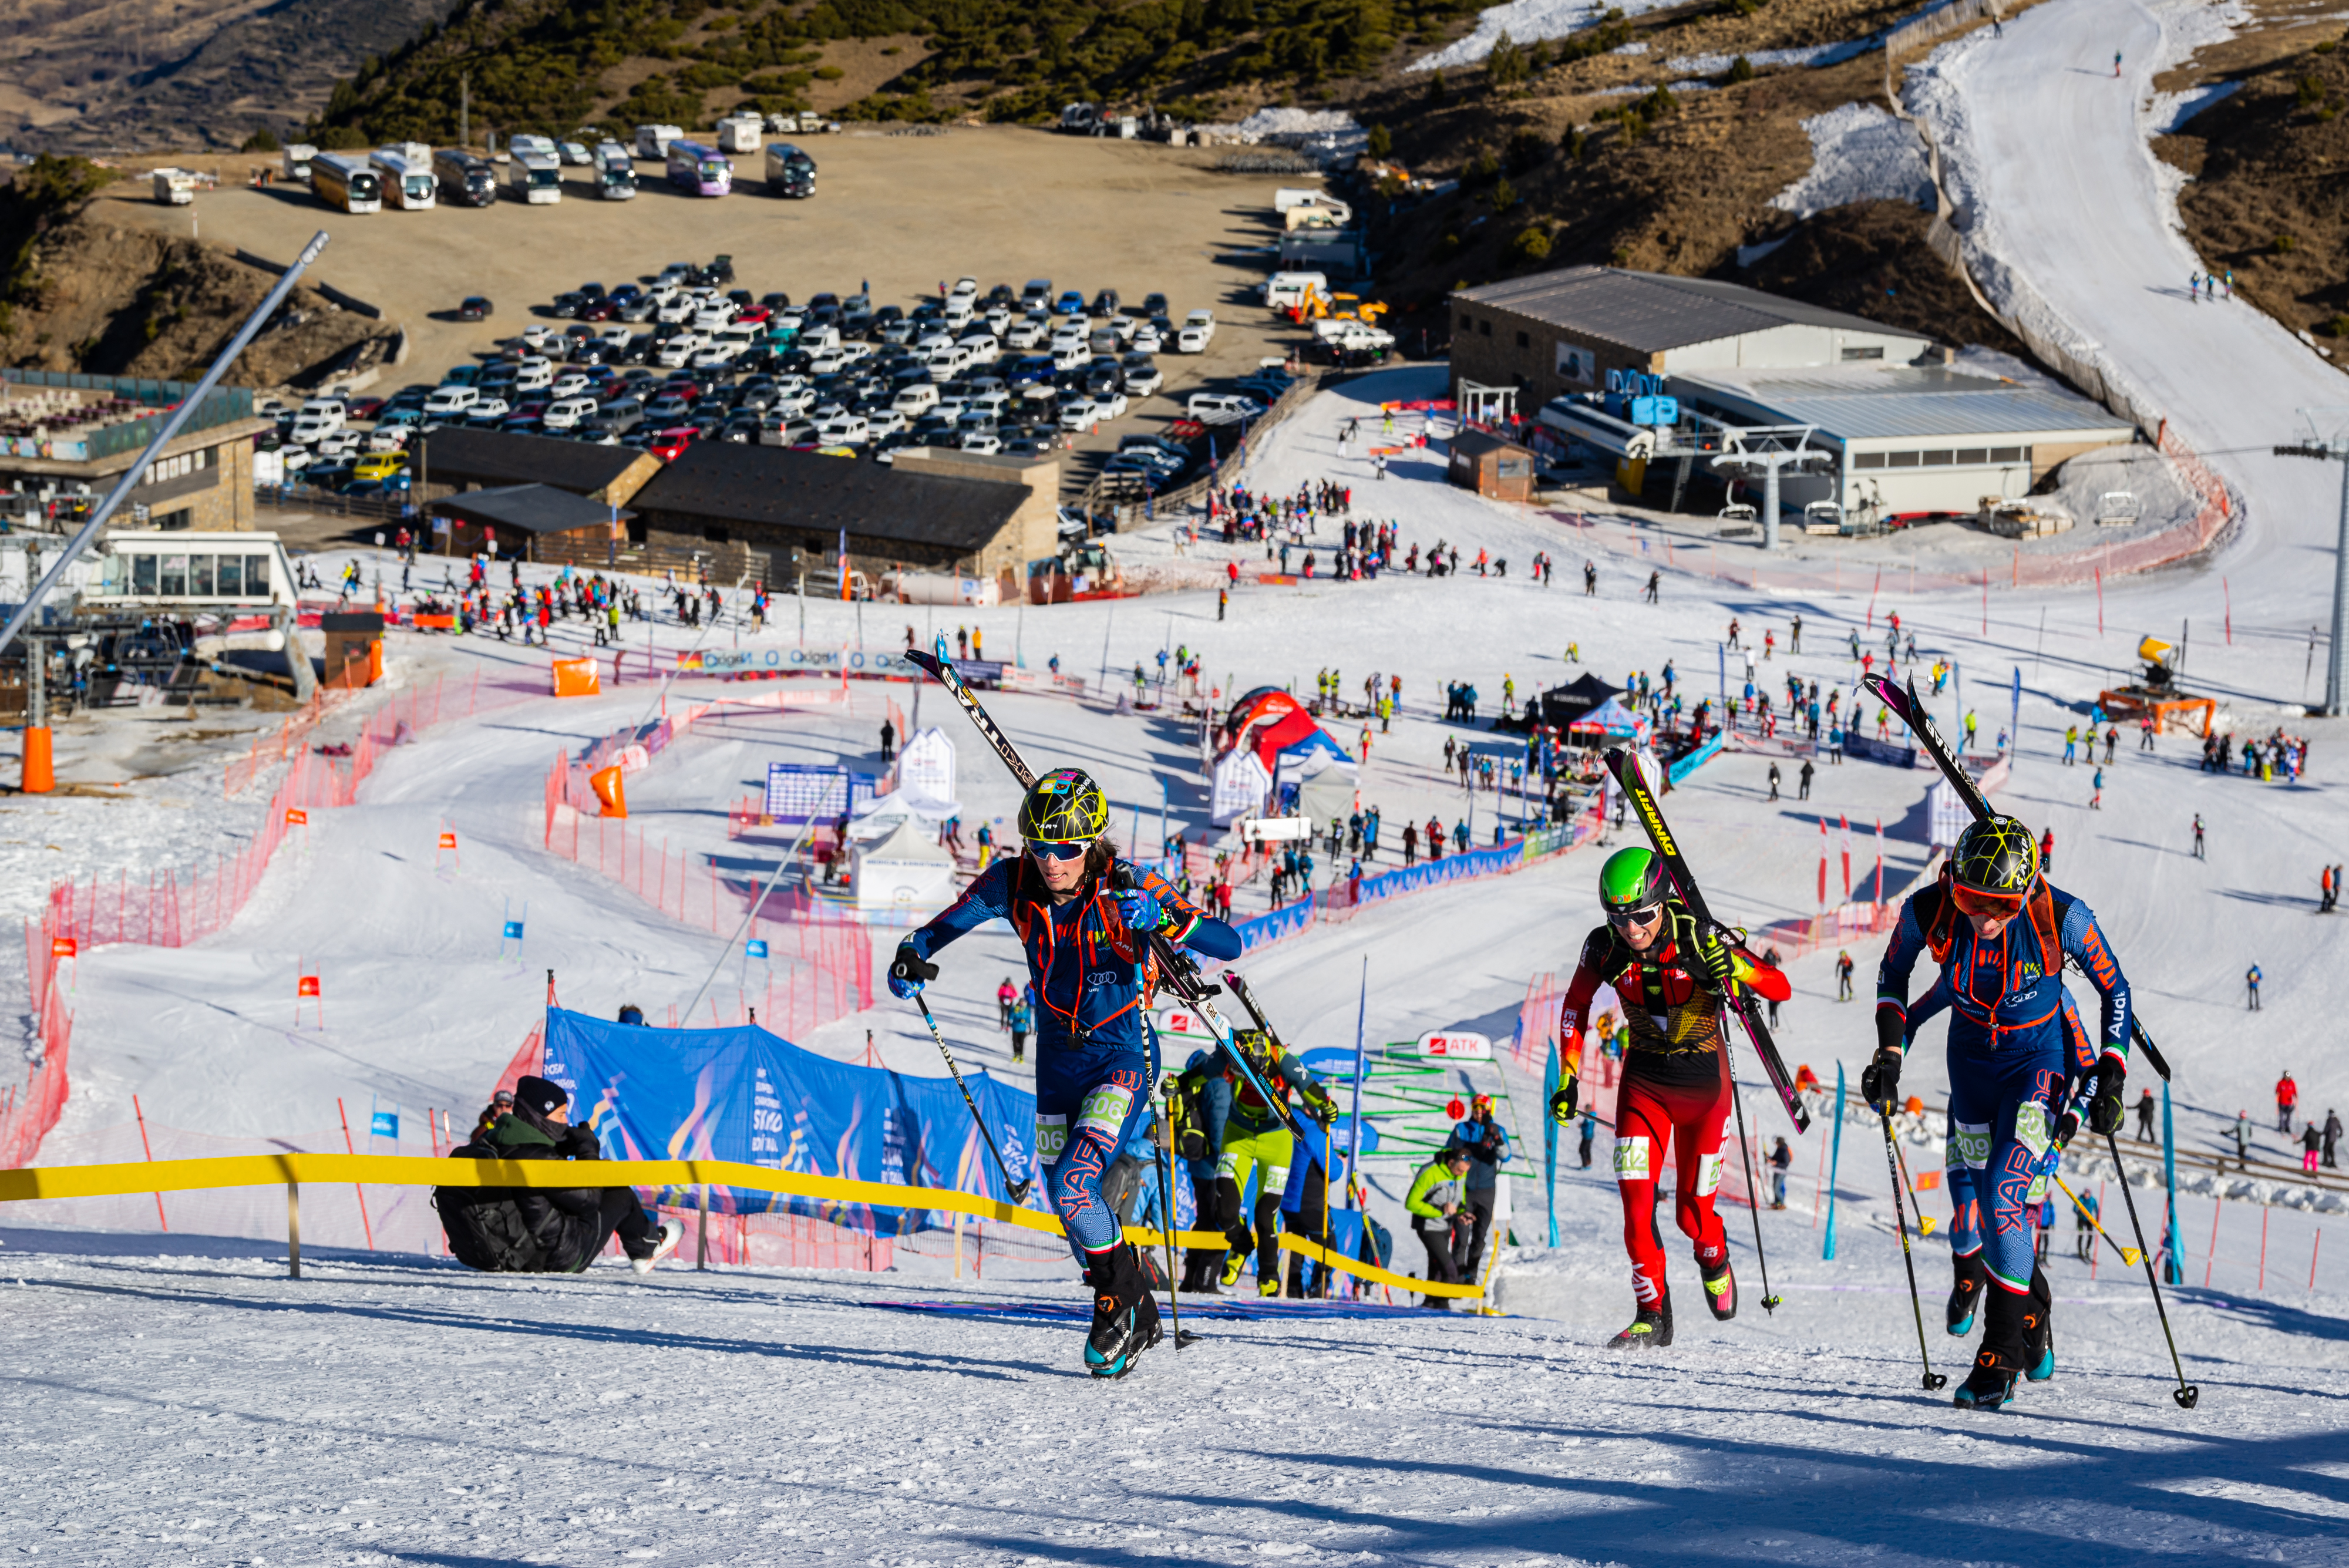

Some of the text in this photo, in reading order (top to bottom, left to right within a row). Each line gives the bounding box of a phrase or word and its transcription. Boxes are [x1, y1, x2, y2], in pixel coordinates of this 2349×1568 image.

[943, 667, 1036, 788] SKITRAB
[1926, 719, 1984, 803] SKITRAB
[1076, 784, 1086, 795] CIAO
[1635, 788, 1677, 856] DYNAFIT
[2017, 837, 2029, 886] CAMP
[1611, 894, 1631, 903] MOM
[2083, 923, 2118, 990] ITALIA
[1206, 1002, 1217, 1019] 162
[1561, 1010, 1577, 1038] ESP
[2065, 1005, 2095, 1067] ITALIA
[1450, 1038, 1478, 1052] ATK
[1081, 1096, 1123, 1120] 206
[1947, 1146, 1963, 1162] 20
[1957, 1132, 1989, 1157] 209
[1614, 1149, 1646, 1168] 212
[1107, 1330, 1130, 1361] SCARPA
[1978, 1391, 2003, 1403] SCARPA
